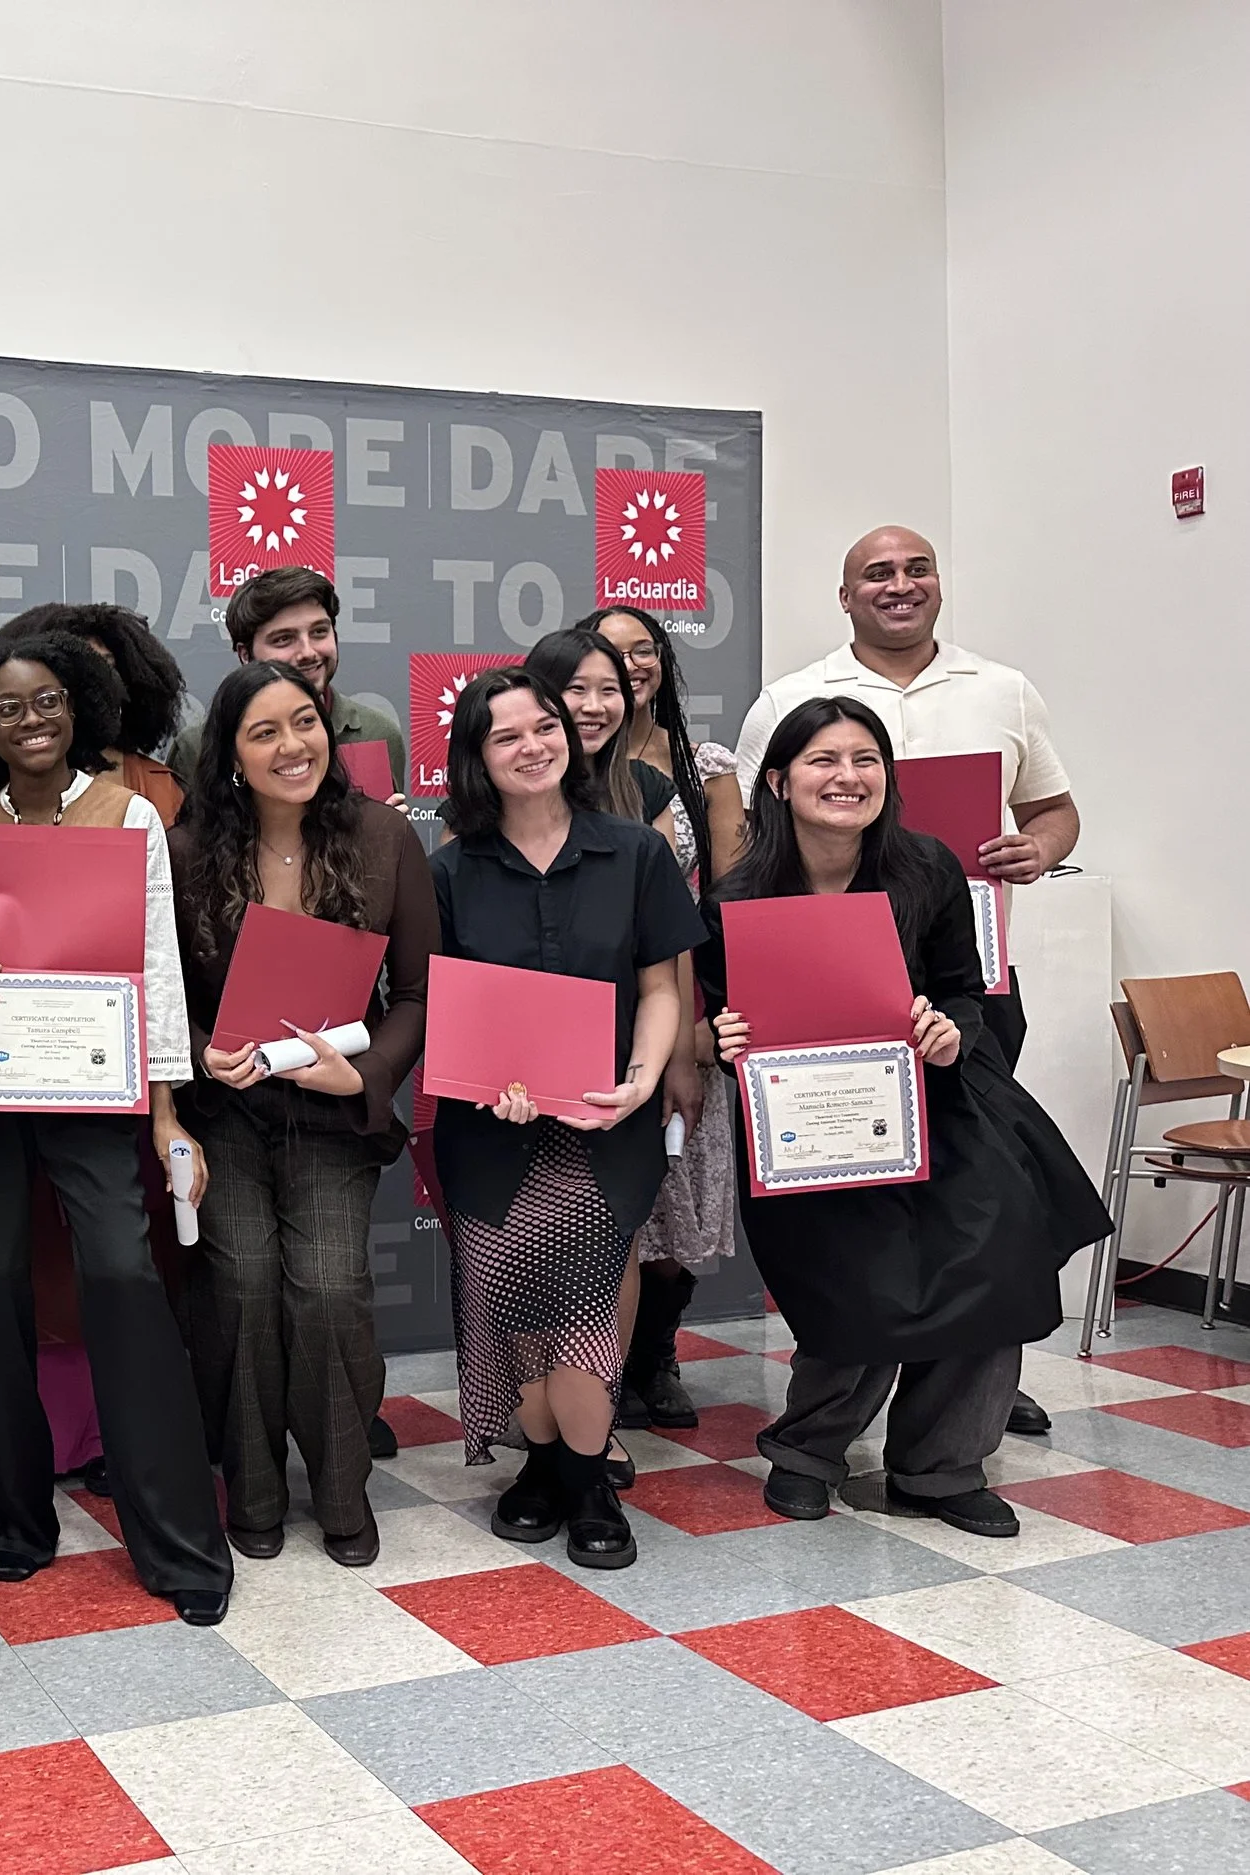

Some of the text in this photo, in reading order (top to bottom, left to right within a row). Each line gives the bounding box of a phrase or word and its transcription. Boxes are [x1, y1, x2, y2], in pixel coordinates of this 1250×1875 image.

[1174, 489, 1195, 502] FIRE
[603, 577, 698, 601] LaGuardia
[90, 546, 391, 644] DAE
[432, 558, 564, 648] TO
[664, 619, 706, 636] College
[10, 1015, 50, 1023] CERTIFICATE
[793, 1090, 831, 1099] CERTIFICATE
[838, 1086, 876, 1095] COMPLETION
